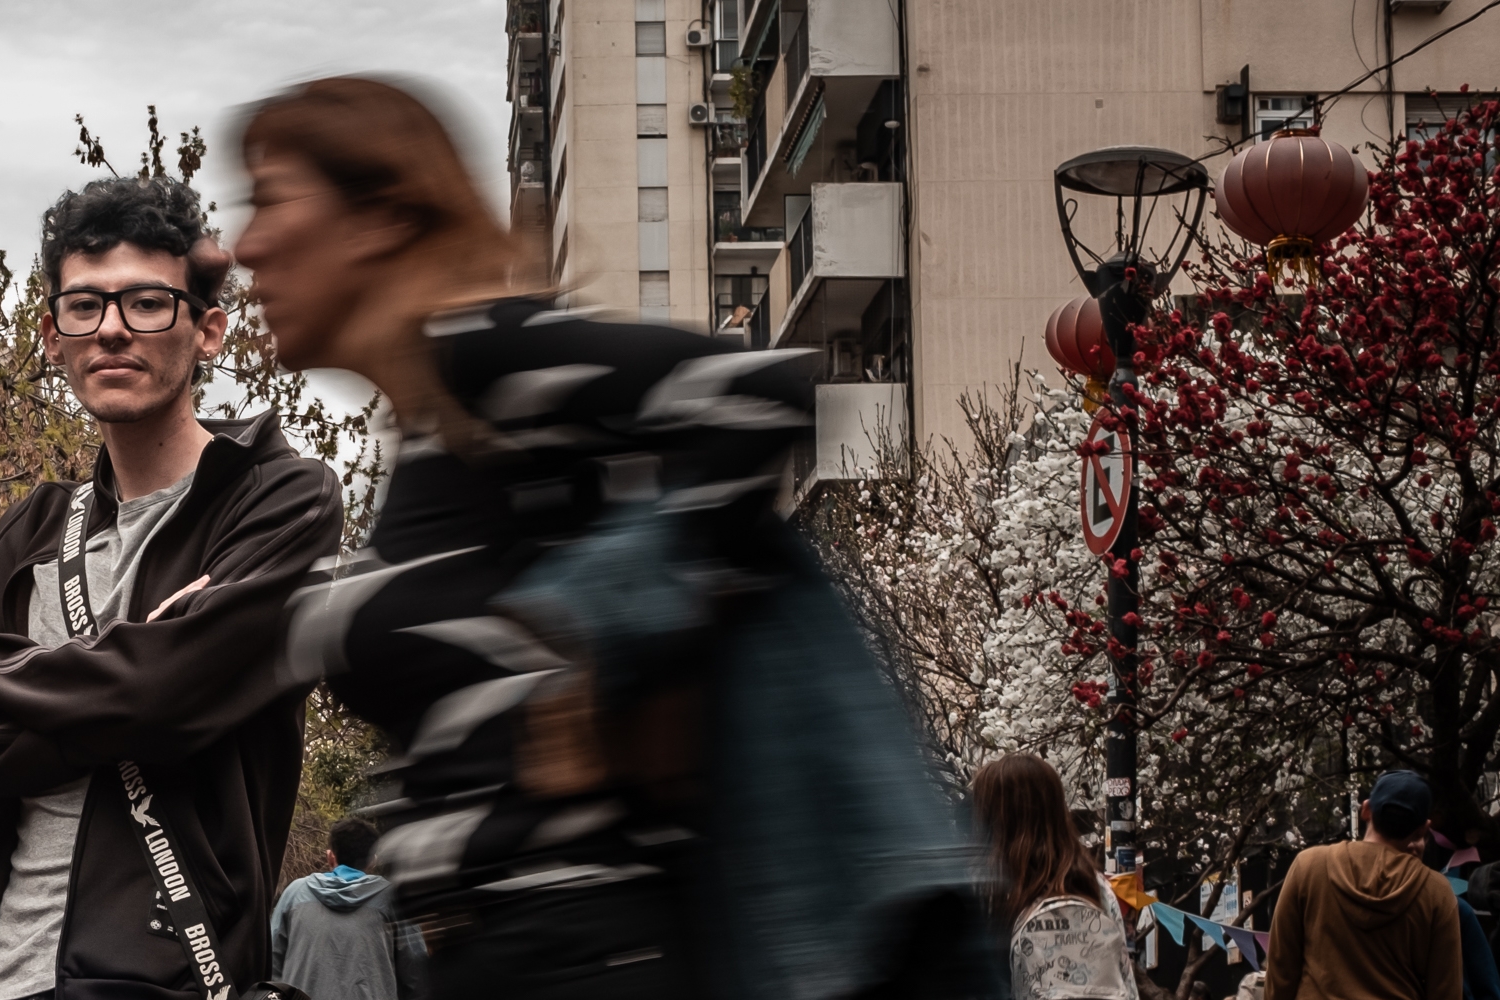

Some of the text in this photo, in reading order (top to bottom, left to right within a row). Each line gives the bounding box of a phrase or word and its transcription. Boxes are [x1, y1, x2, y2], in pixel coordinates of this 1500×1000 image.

[63, 510, 85, 563] LONDON
[64, 574, 88, 631] BROSS
[117, 760, 147, 801] ROSS
[144, 829, 191, 903] LONDON
[184, 923, 224, 987] BROSS
[1026, 918, 1070, 932] PARIS
[1055, 932, 1089, 946] FRANCE
